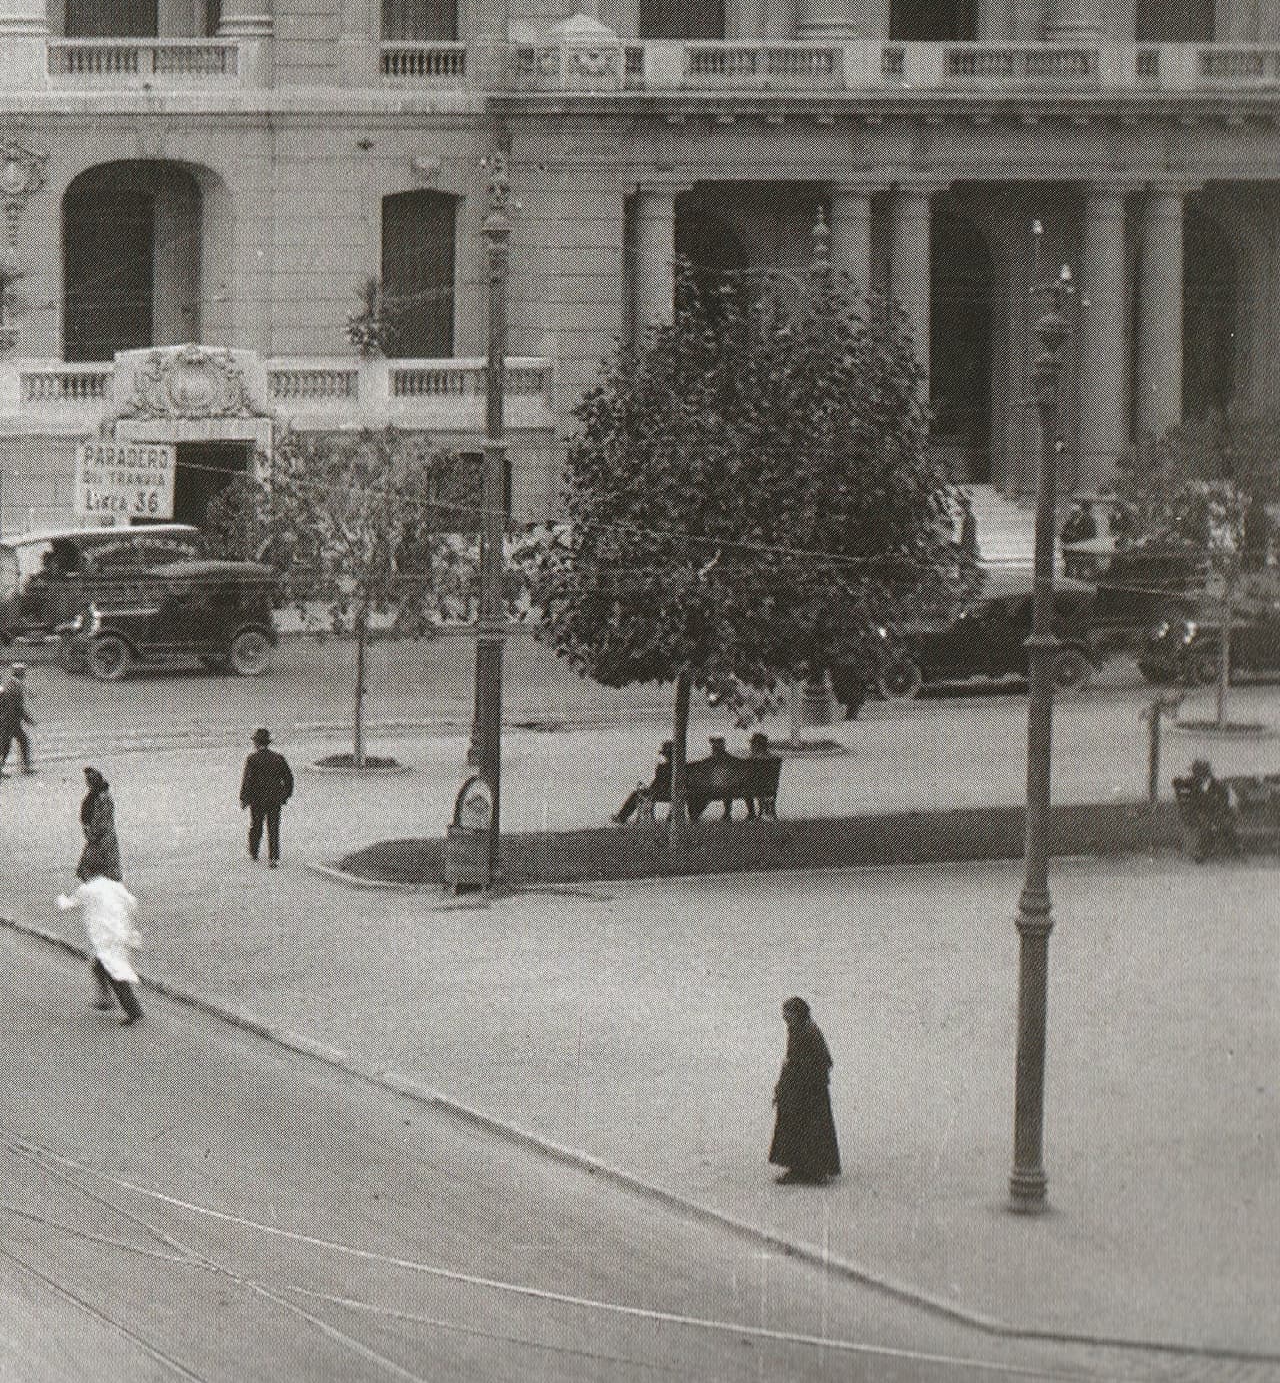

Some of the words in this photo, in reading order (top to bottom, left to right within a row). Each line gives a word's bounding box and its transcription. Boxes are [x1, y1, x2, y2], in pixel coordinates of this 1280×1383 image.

[83, 445, 168, 470] PARADERO
[108, 470, 165, 486] TRANVIA
[134, 492, 159, 514] 36
